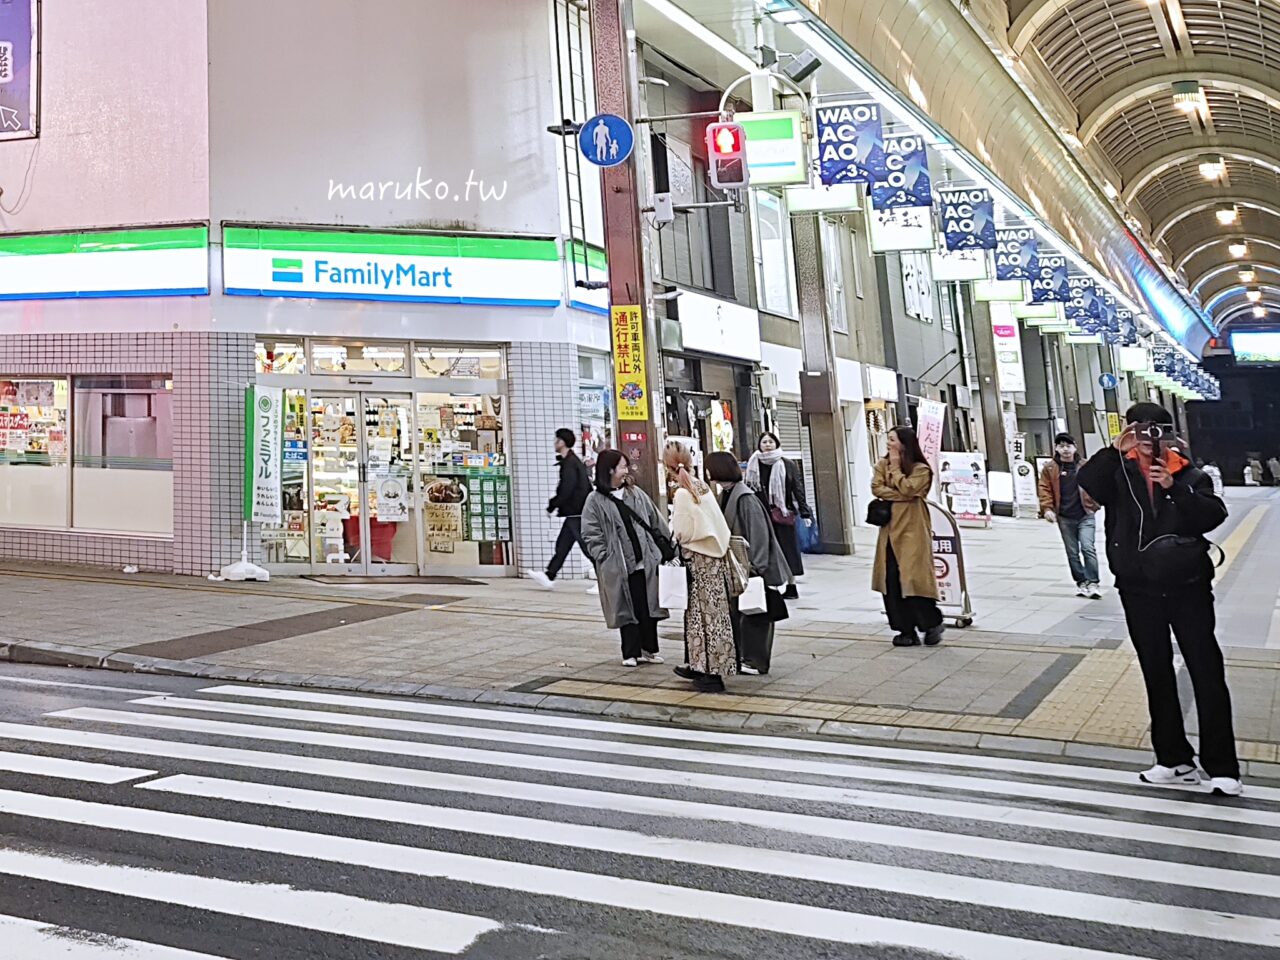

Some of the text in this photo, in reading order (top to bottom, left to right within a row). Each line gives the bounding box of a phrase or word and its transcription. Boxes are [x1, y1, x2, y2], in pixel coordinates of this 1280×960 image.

[819, 106, 878, 124] WAO!
[821, 124, 857, 143] AC
[822, 143, 858, 162] AO
[941, 190, 989, 205] WAO!
[945, 204, 974, 218] AC
[946, 219, 975, 233] AO
[314, 260, 453, 291] FamilyMart
[614, 311, 632, 375] 通行禁止
[629, 311, 642, 374] 許可車両以外
[258, 415, 272, 480] ファミマル
[284, 451, 304, 460] たばこ
